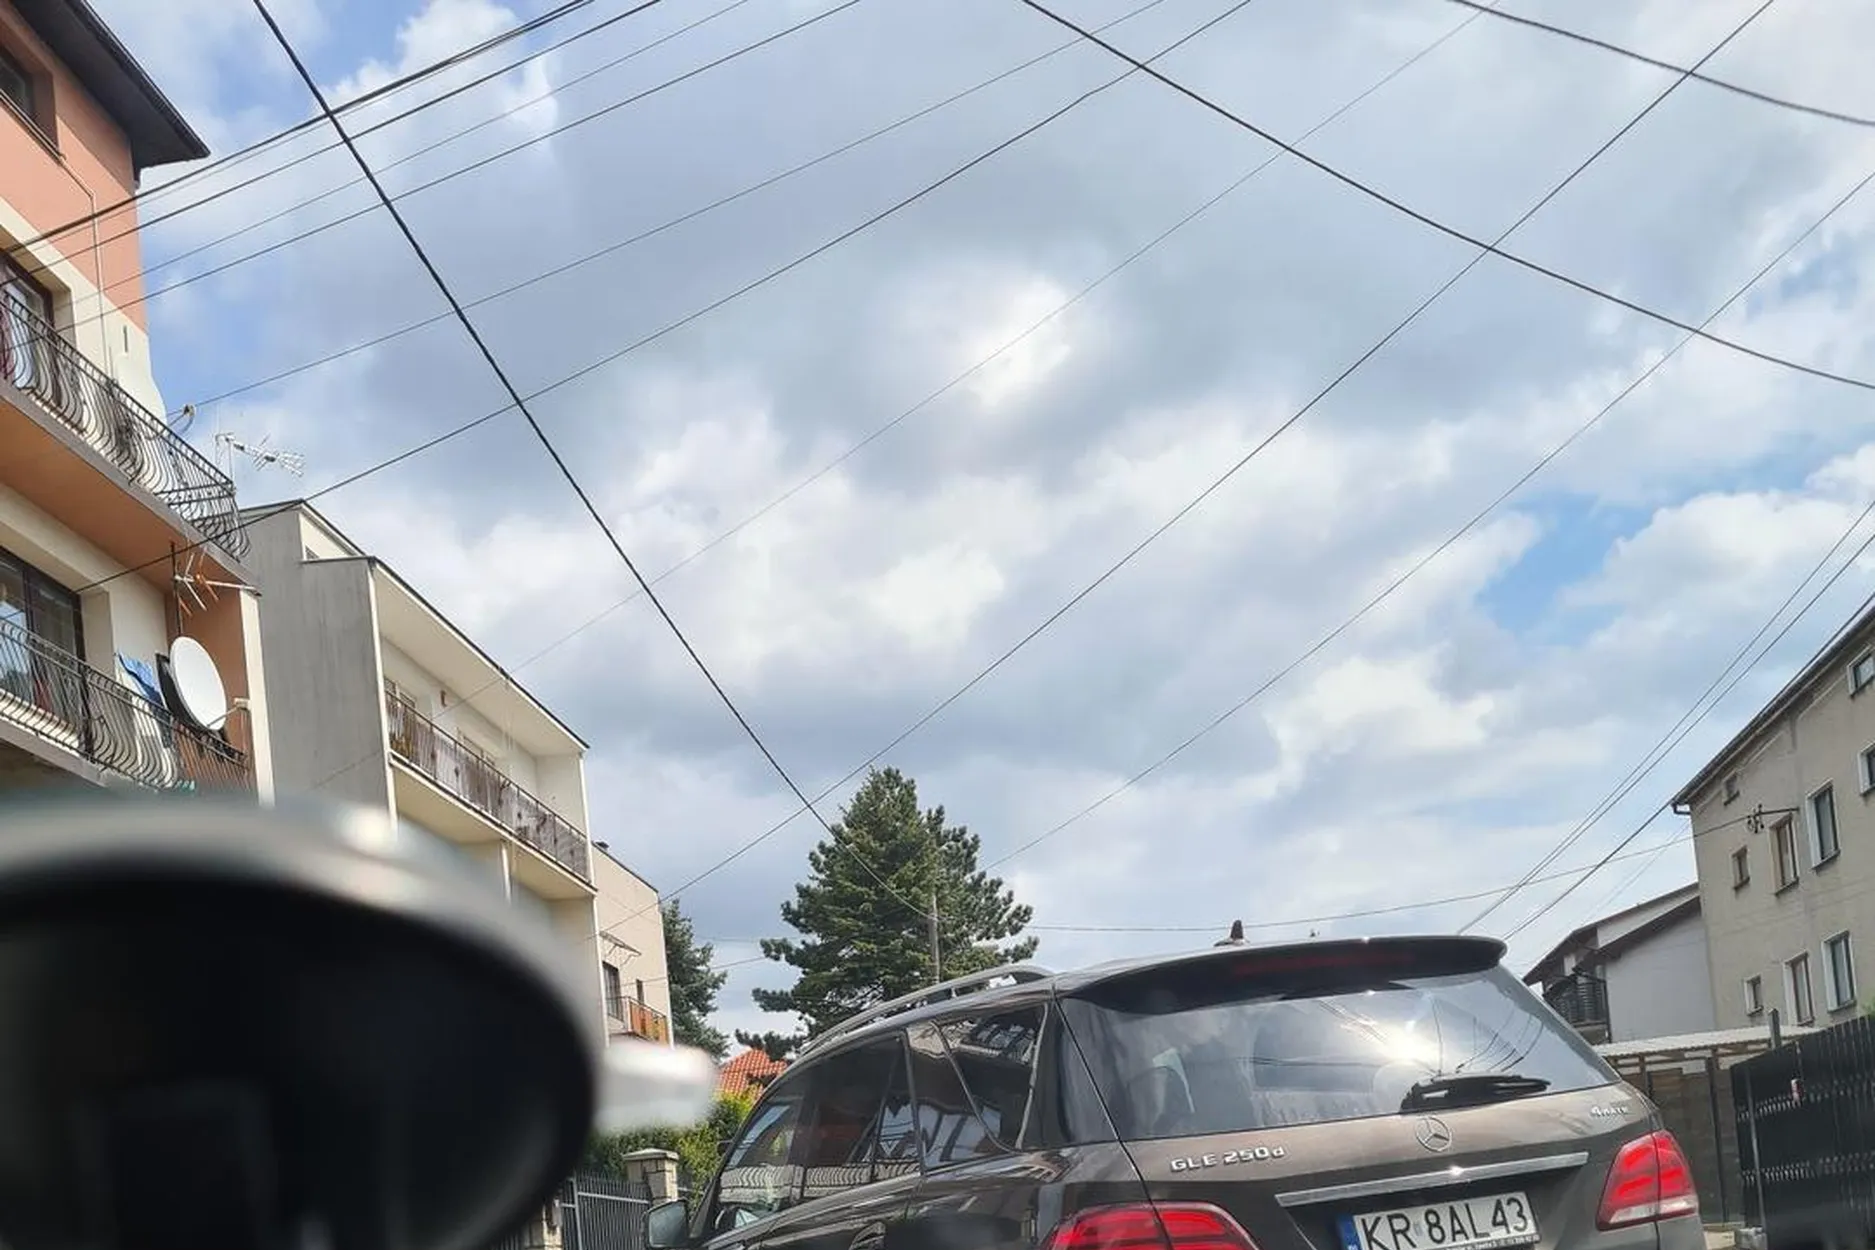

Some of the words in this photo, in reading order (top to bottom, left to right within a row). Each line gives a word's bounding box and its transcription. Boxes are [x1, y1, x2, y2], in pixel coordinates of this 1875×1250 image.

[1170, 1153, 1217, 1172] GLE
[1223, 1146, 1285, 1165] 250d
[1423, 1197, 1529, 1245] 8AL43
